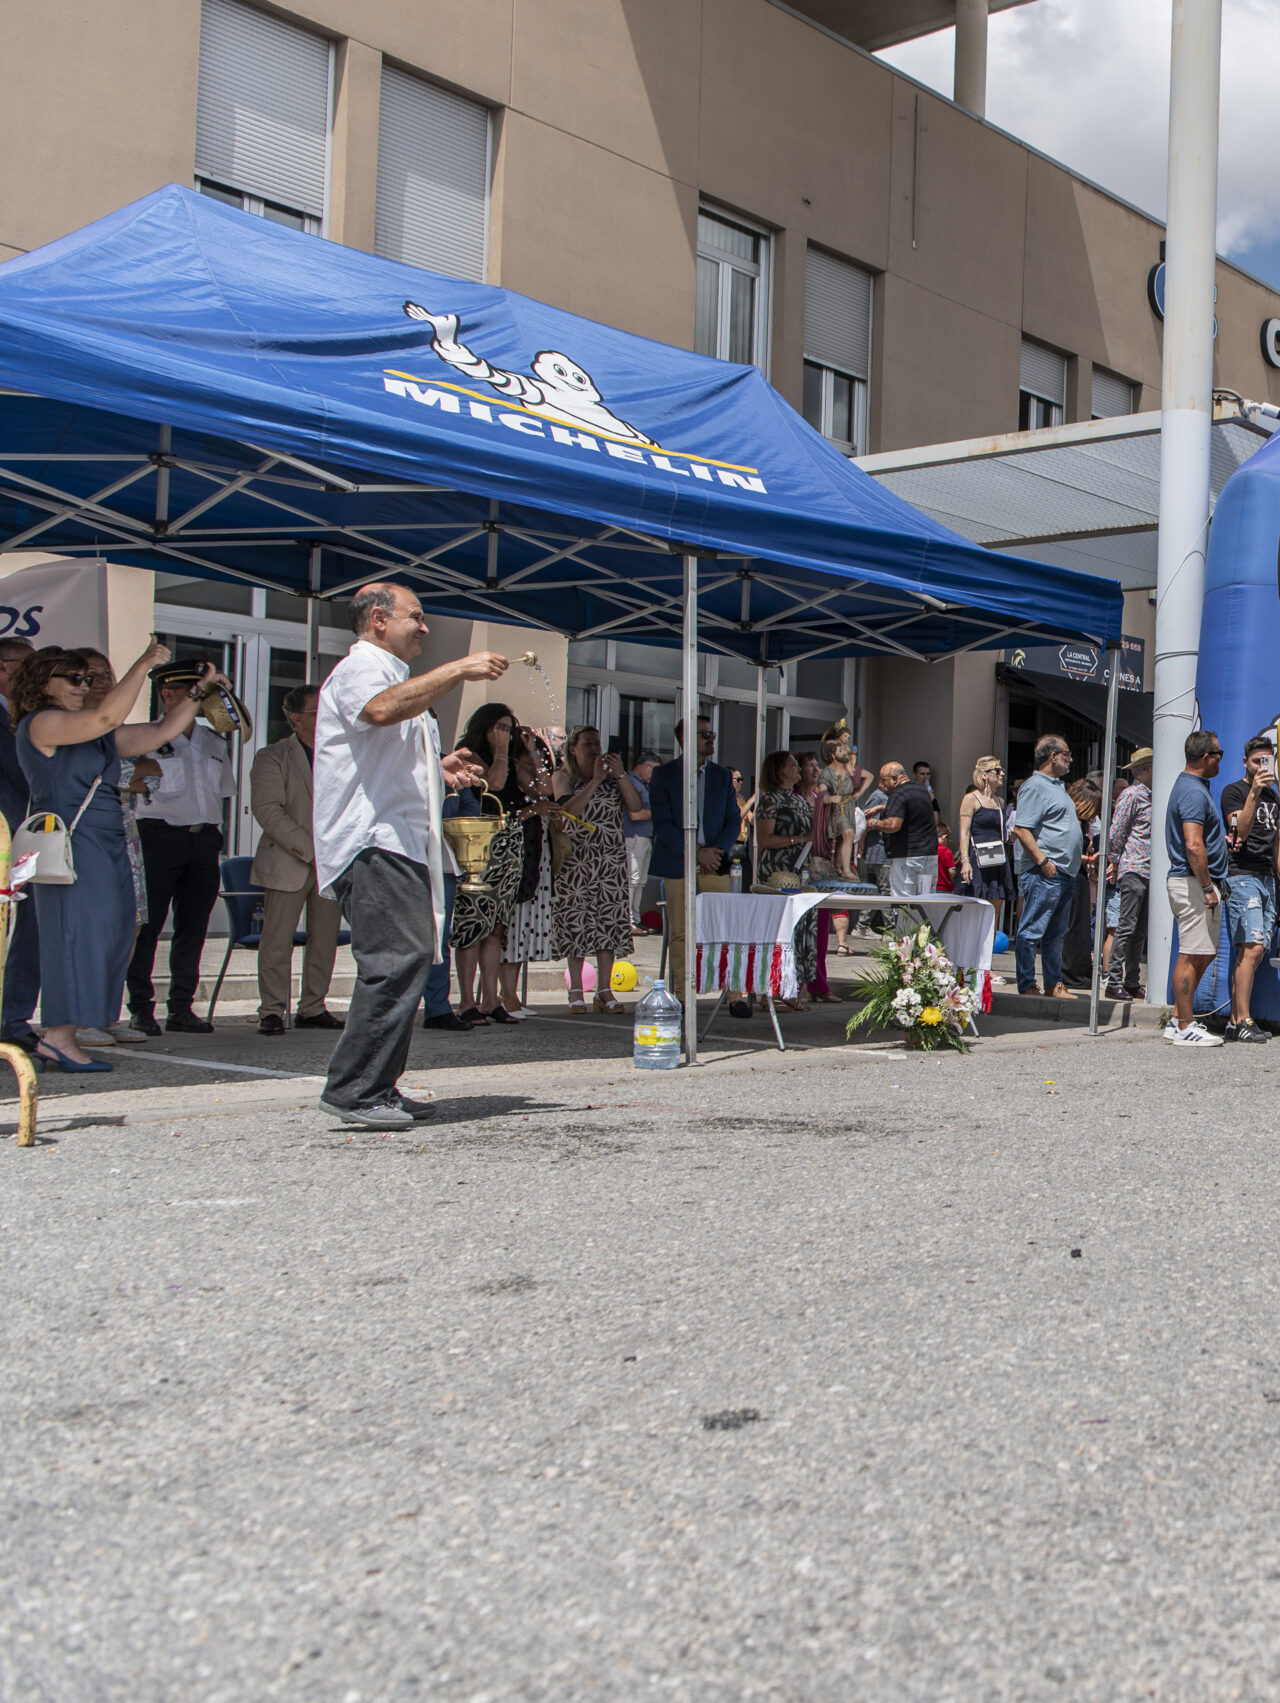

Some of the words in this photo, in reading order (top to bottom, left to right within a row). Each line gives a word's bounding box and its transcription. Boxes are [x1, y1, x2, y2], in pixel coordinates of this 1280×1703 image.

[383, 377, 768, 494] MICHELIN
[1073, 653, 1090, 662] CENTRAL
[1103, 669, 1135, 683] CNES
